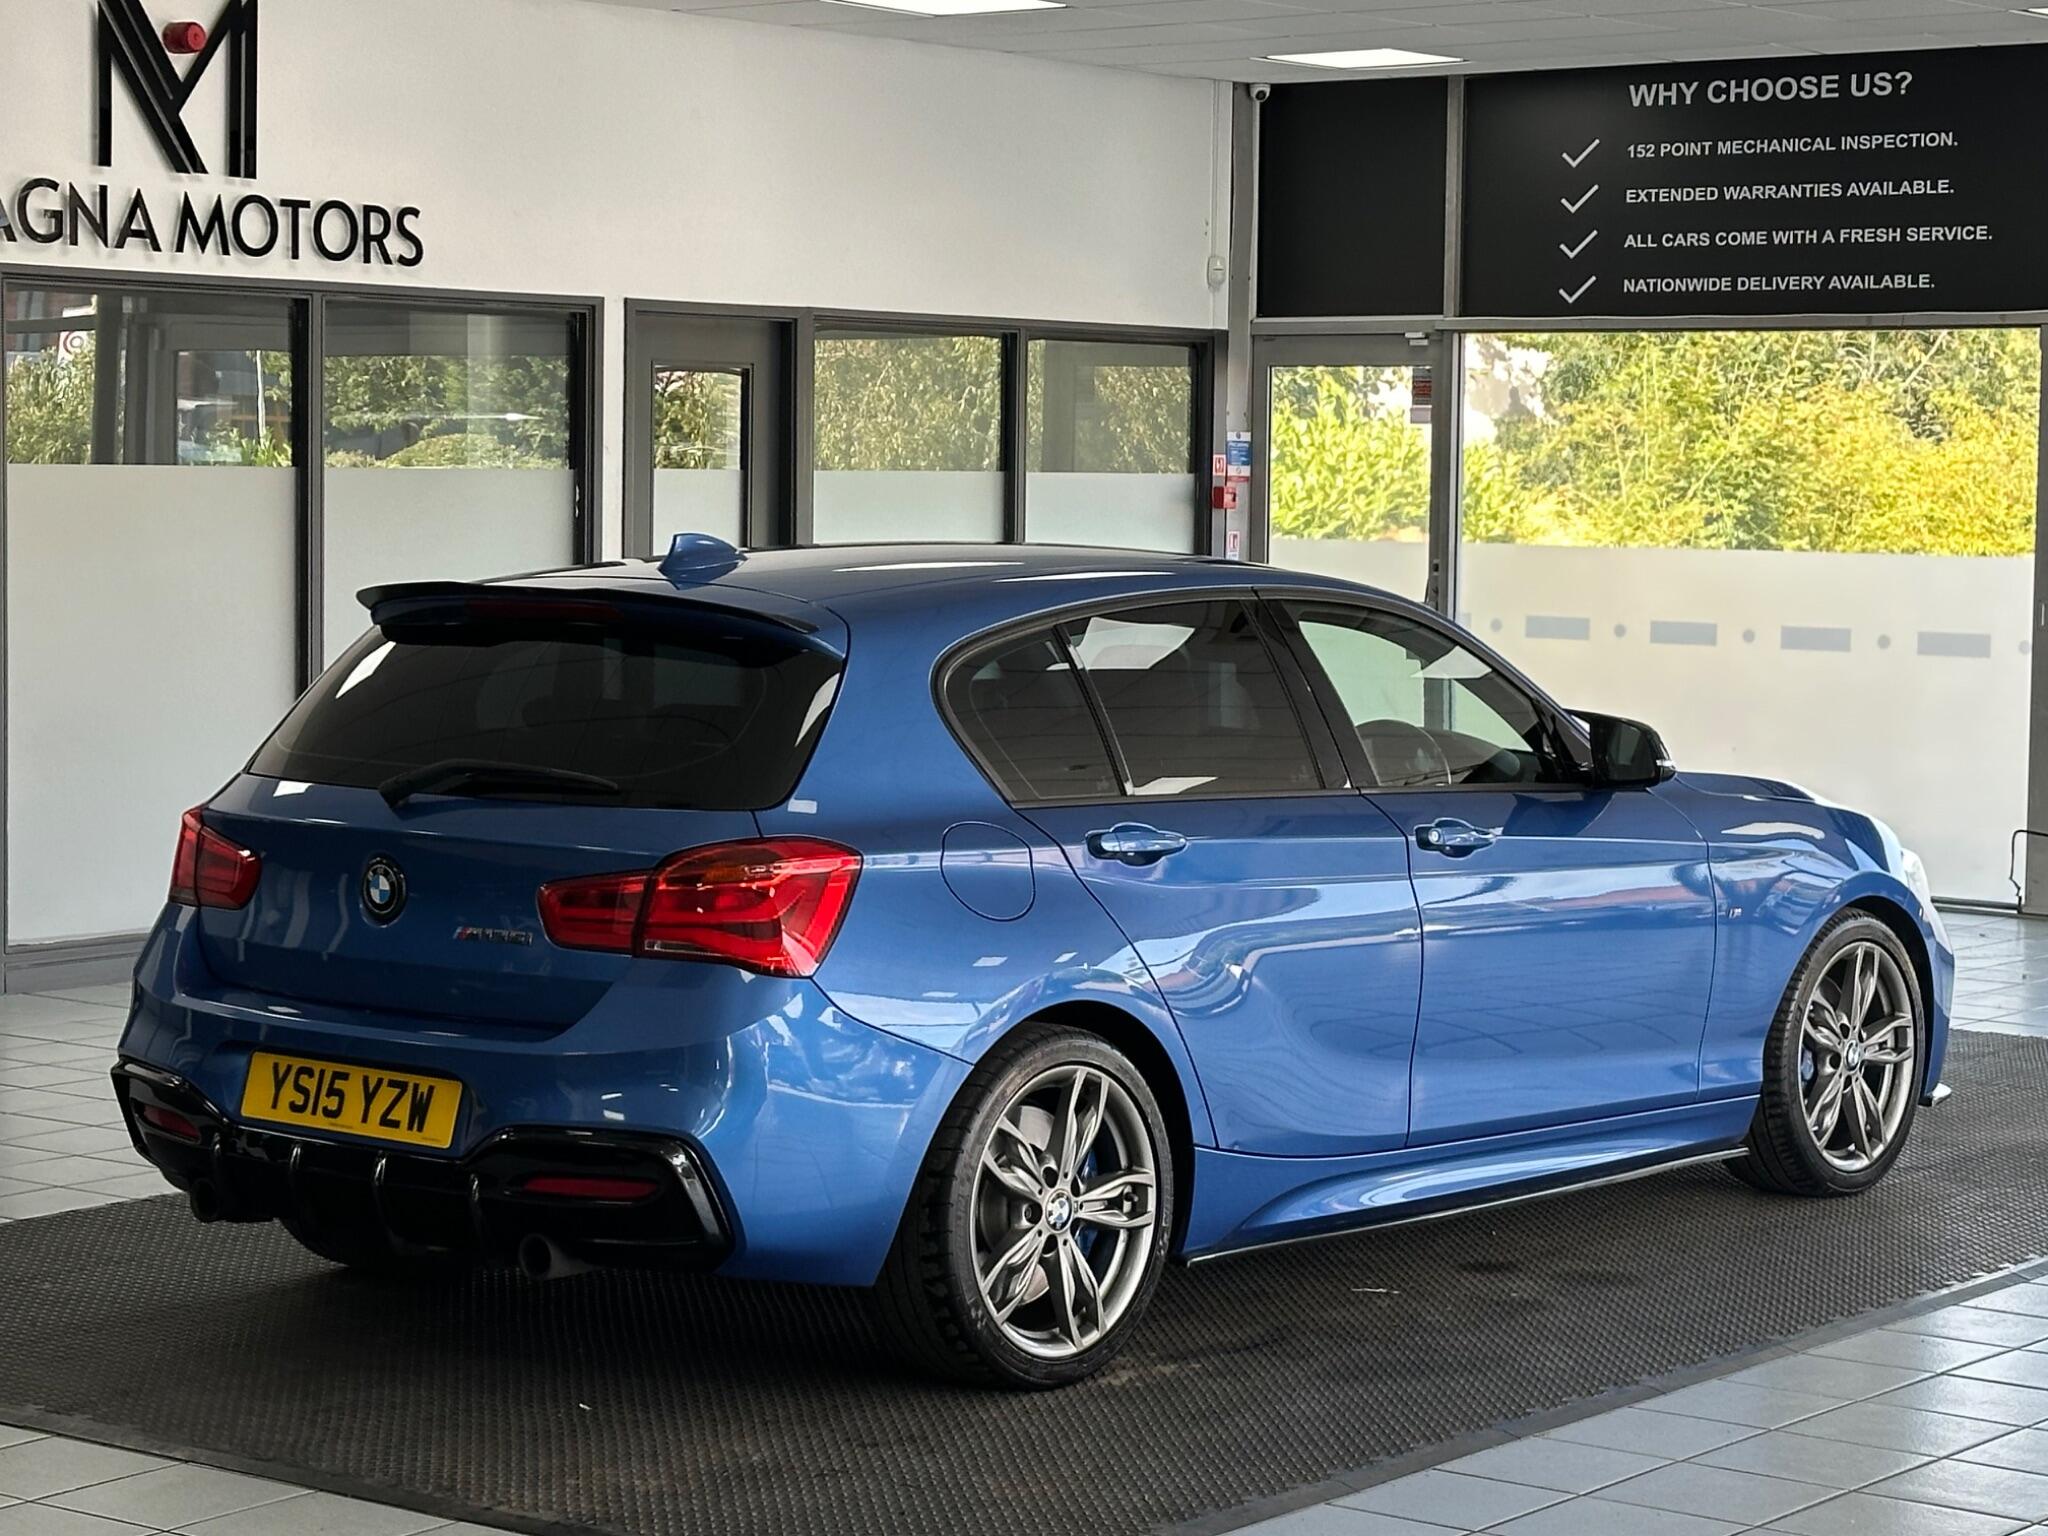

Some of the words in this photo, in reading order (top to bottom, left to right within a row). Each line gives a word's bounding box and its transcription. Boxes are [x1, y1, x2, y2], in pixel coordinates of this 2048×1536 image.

[1629, 81, 1699, 107] WHY
[1707, 74, 1840, 104] CHOOSE
[1850, 71, 1913, 97] US?
[1627, 143, 1656, 159] 152
[1660, 141, 1713, 158] POINT
[1717, 136, 1837, 155] MECHANICAL
[1841, 131, 1958, 151] INSPECTION.
[1625, 186, 1719, 203] EXTENDED
[1723, 182, 1843, 201] WARRANTIES
[1846, 179, 1955, 197] AVAILABLE.
[174, 190, 425, 268] MOTORS
[1623, 233, 1658, 248] ALL
[1661, 232, 1710, 248] CARS
[1715, 230, 1768, 246] COME
[1772, 229, 1818, 245] WITH
[1821, 229, 1836, 244] A
[1839, 227, 1901, 244] FRESH
[1906, 225, 1993, 242] SERVICE.
[1623, 277, 1732, 293] NATIONWIDE
[1737, 275, 1825, 291] DELIVERY
[1828, 273, 1935, 290] AVAILABLE.
[271, 1061, 350, 1120] YS15
[360, 1074, 436, 1134] YZW
